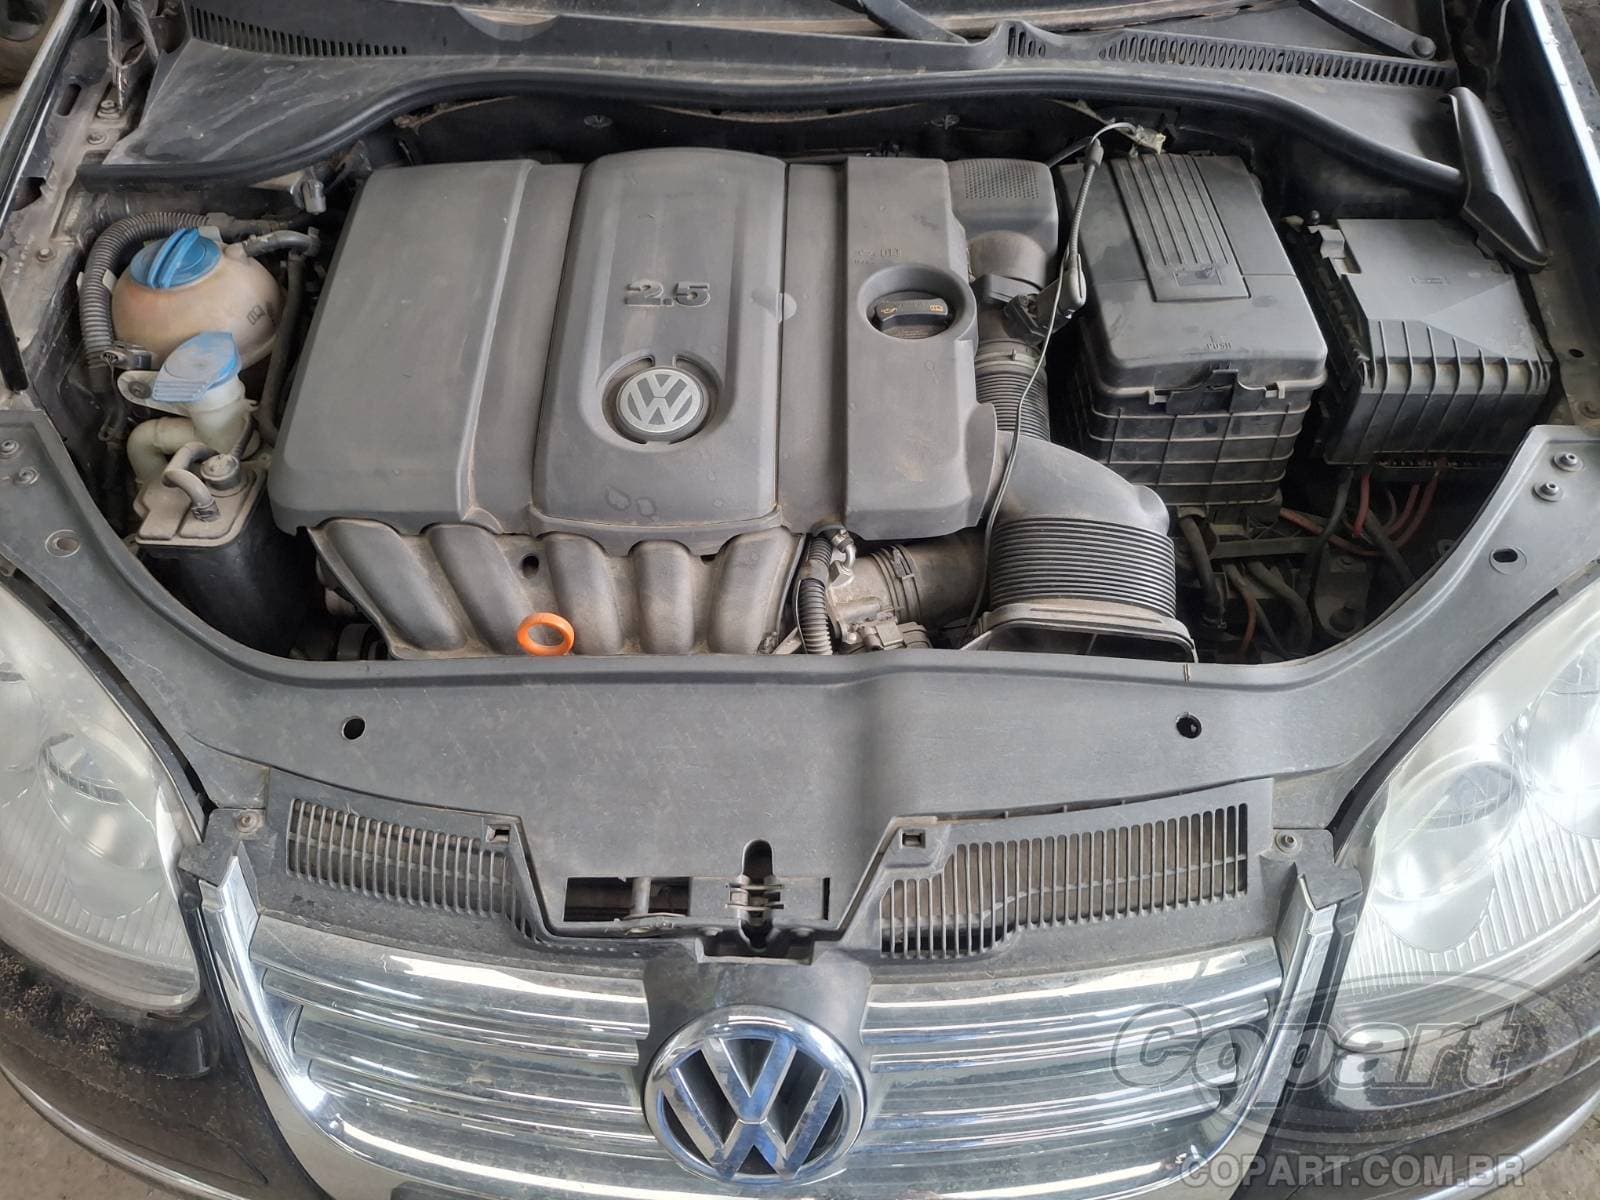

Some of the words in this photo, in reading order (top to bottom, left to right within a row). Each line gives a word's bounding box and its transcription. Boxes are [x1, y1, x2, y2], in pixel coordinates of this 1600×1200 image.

[624, 281, 711, 308] 2.5
[622, 368, 701, 433] VW
[652, 1020, 855, 1184] VW
